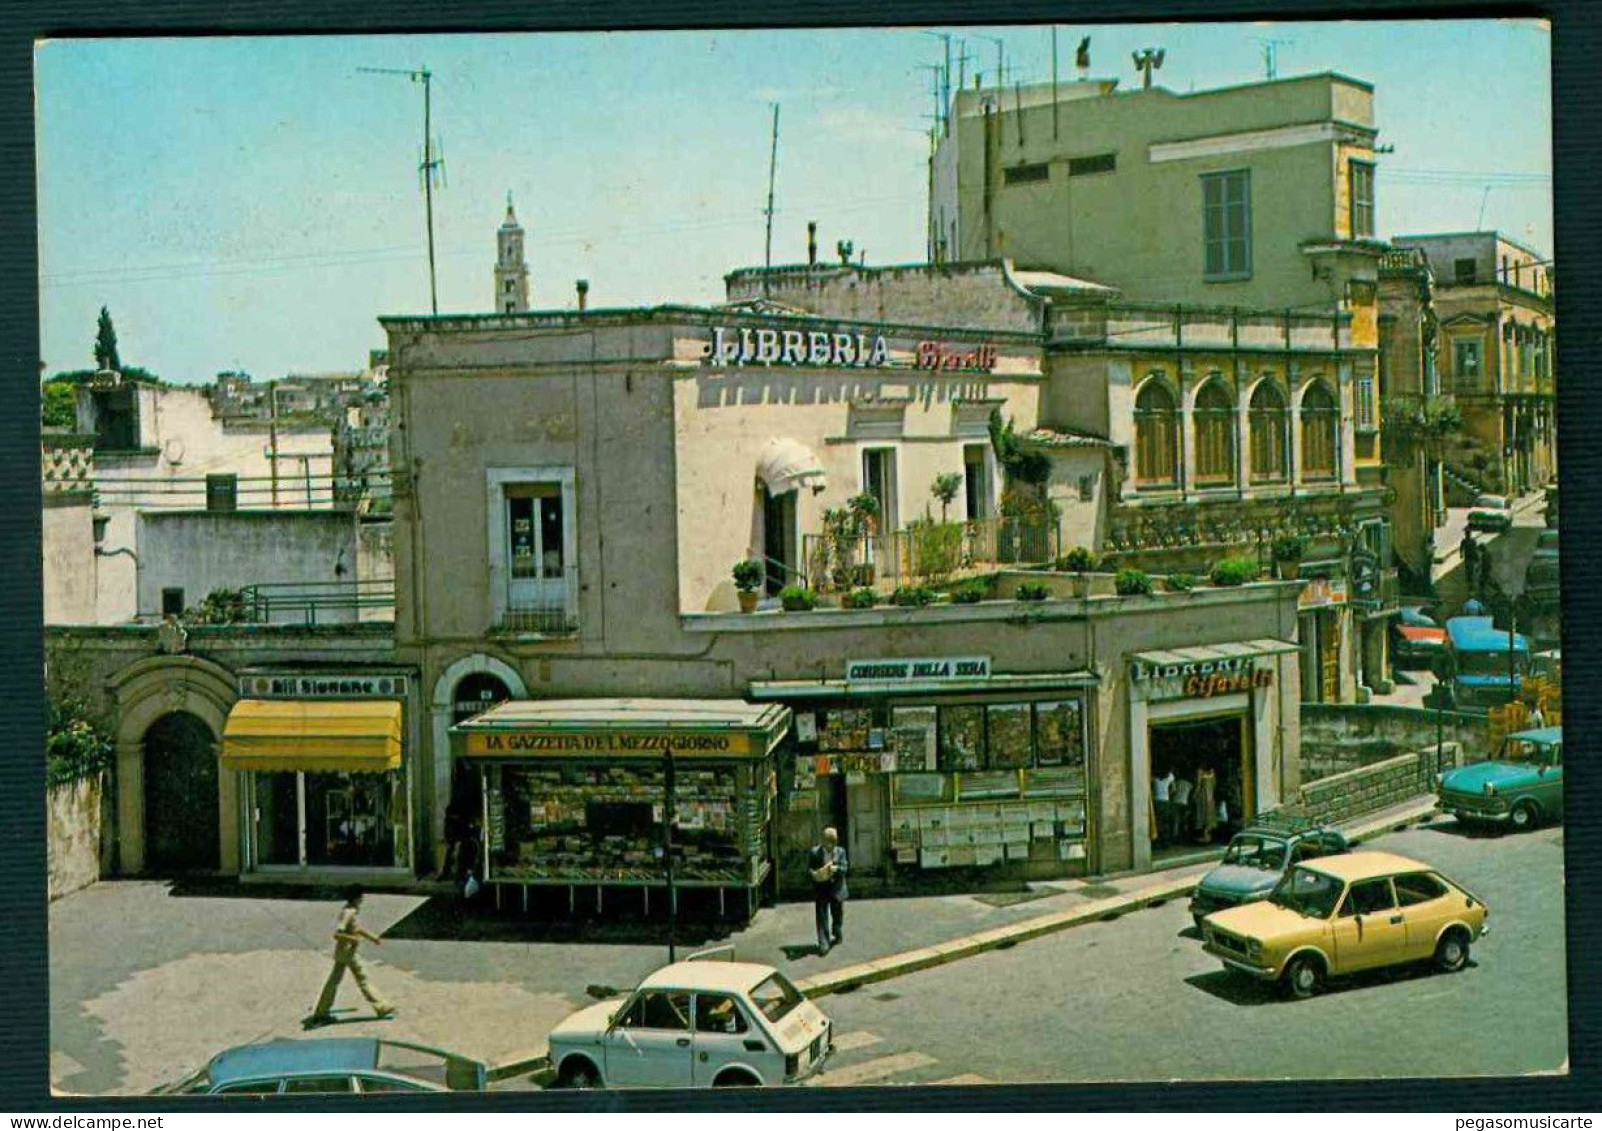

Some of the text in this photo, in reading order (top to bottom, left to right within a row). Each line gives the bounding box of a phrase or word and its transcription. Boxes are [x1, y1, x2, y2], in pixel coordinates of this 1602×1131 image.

[711, 326, 889, 366] LIBRERIA
[850, 661, 987, 679] CORRIERE DELLA SERA
[485, 733, 503, 751] LA
[508, 733, 579, 751] GAZZETTA
[620, 733, 730, 751] MEZZOGIORNO
